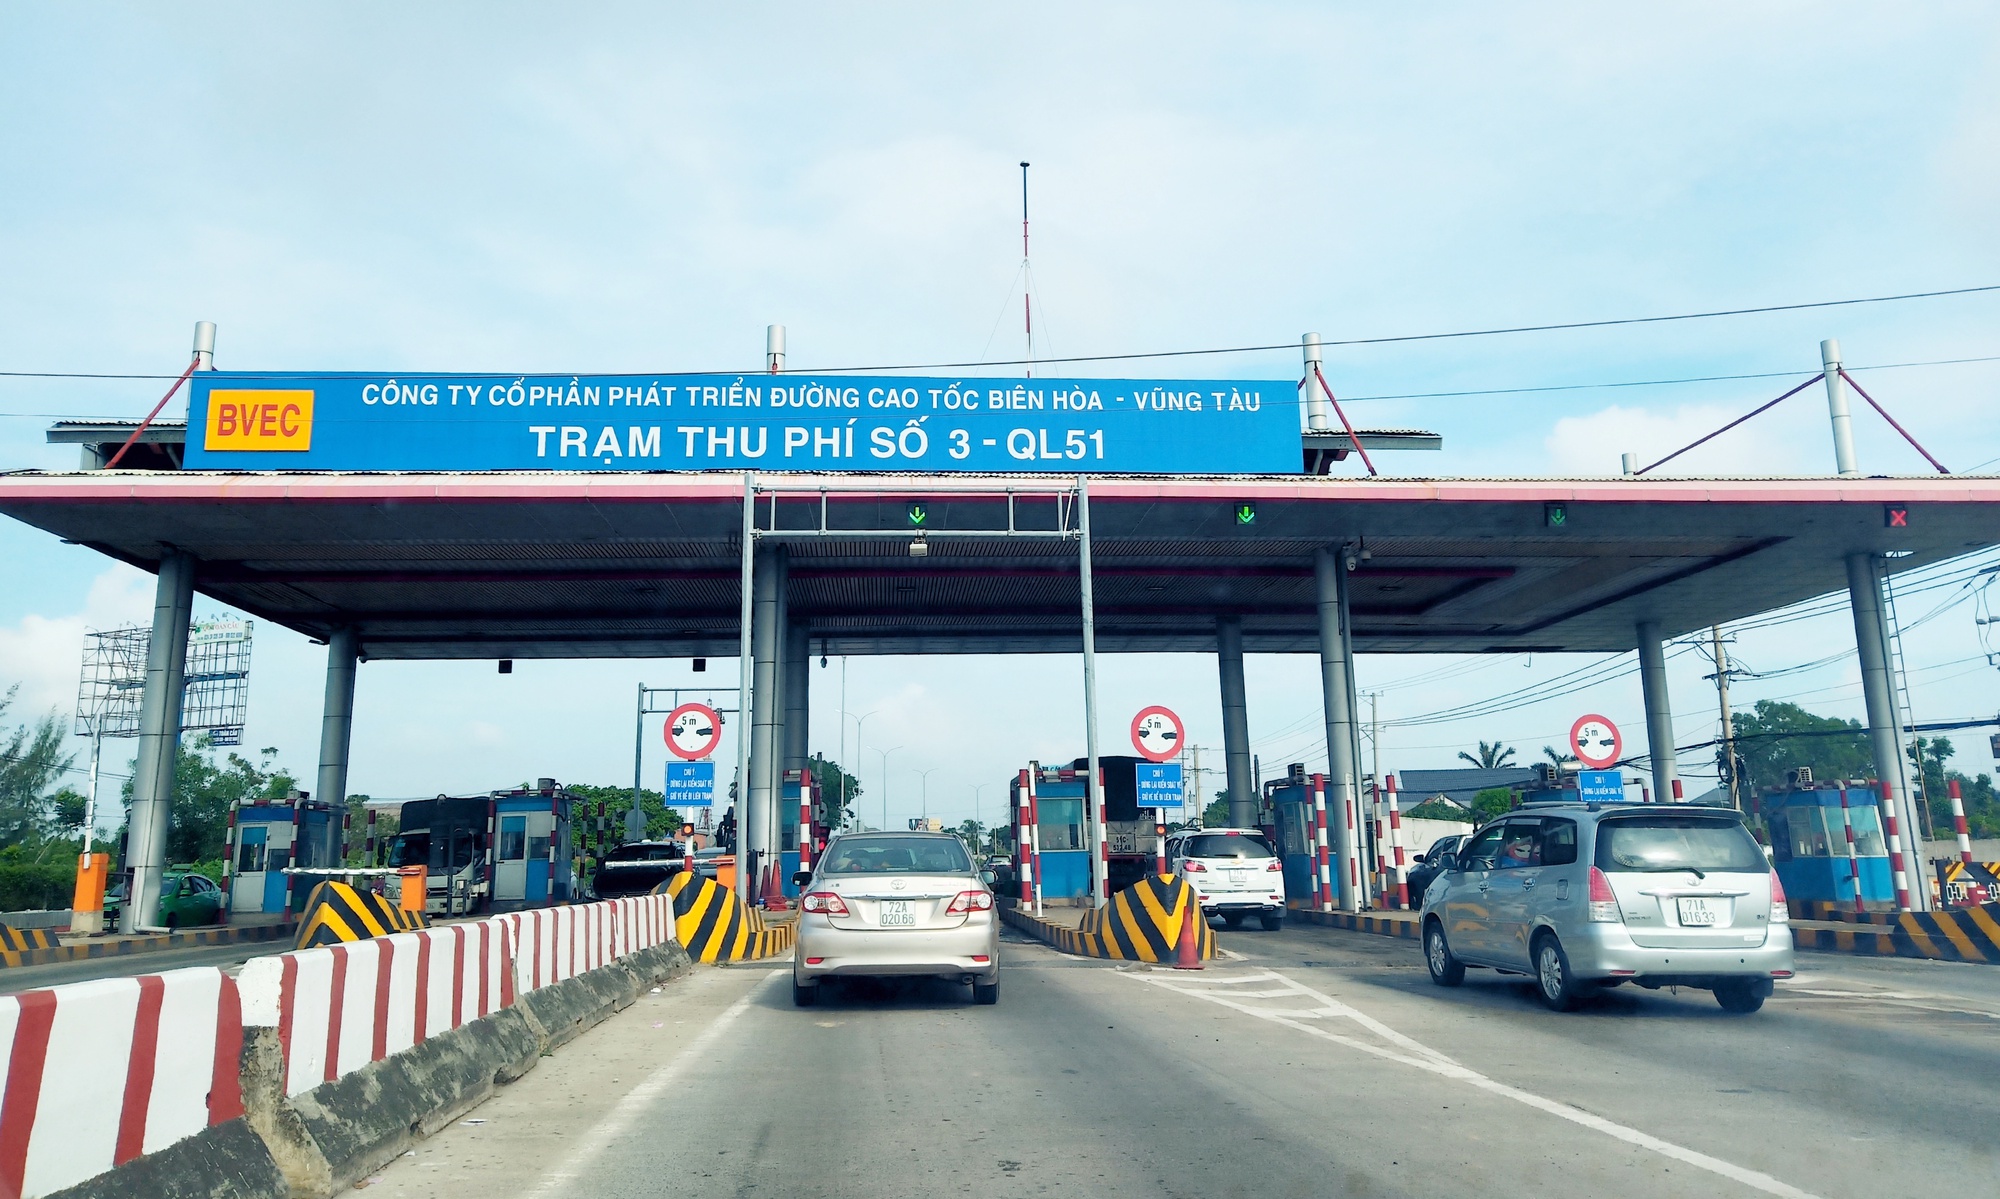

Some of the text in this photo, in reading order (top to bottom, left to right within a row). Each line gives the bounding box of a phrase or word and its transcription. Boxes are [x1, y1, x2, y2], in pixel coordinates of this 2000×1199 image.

[362, 375, 439, 406] CÔNG
[448, 385, 483, 406] TY
[609, 381, 677, 407] PHÁT
[686, 376, 762, 407] TRIỂN
[770, 380, 860, 409] ĐƯỜNG
[867, 387, 919, 409] CAO
[927, 381, 979, 411] TỐC
[988, 384, 1044, 410] BIÊN
[1052, 384, 1104, 411] HÒA
[1133, 386, 1203, 412] VŨNG
[1210, 387, 1261, 412] TÀU
[217, 403, 301, 438] BVEC
[528, 426, 661, 464] TRẠM
[677, 426, 768, 458] THU
[784, 417, 858, 458] PHÍ
[869, 415, 930, 459] SỐ
[948, 428, 971, 460] 3
[1006, 428, 1104, 461] QL51
[682, 716, 687, 725] 5
[1147, 719, 1152, 728] 5
[1585, 728, 1589, 736] 5
[888, 901, 907, 913] 72A
[1686, 899, 1706, 911] 71A
[881, 913, 914, 925] 020.66
